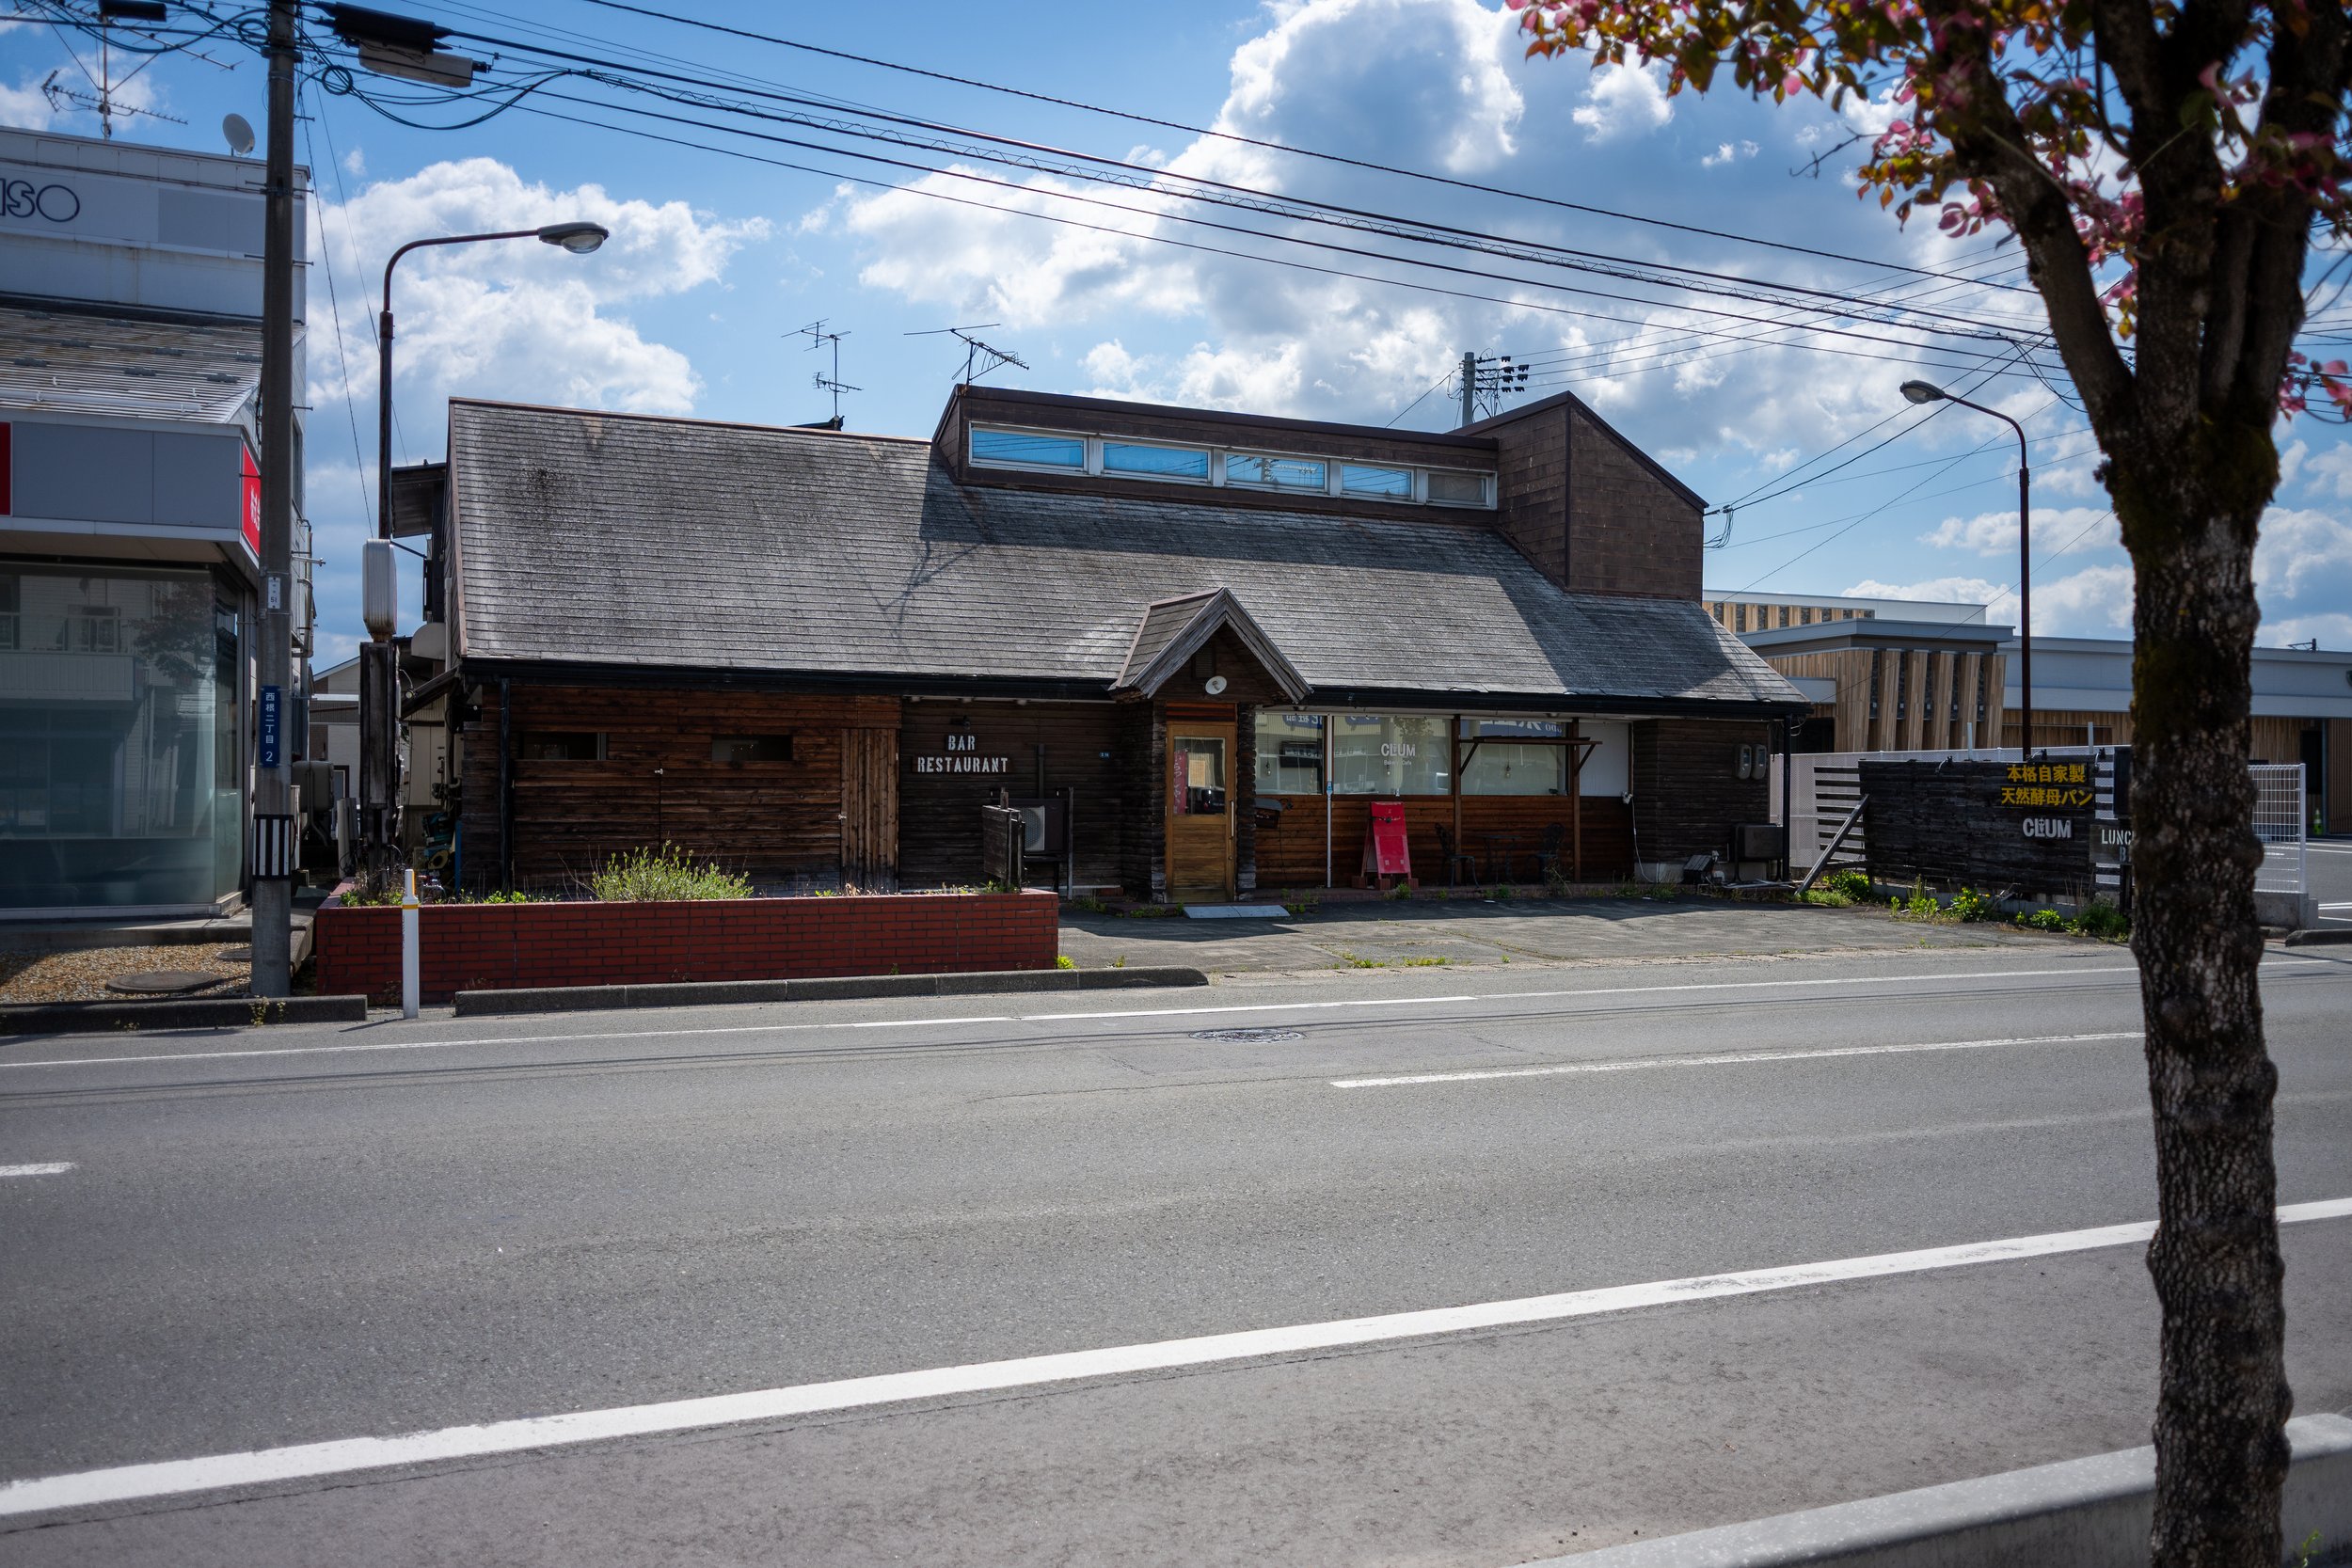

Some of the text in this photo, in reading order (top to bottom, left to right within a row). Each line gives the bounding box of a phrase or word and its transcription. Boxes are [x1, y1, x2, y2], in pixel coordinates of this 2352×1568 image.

[265, 692, 276, 762] 西根二丁目 2
[947, 735, 976, 751] BAR
[1380, 743, 1416, 757] CLUM
[917, 756, 1009, 773] RESTAURANT
[2007, 764, 2086, 784] 本格自家製
[2001, 787, 2093, 806] 天然酵母パン
[2023, 817, 2073, 839] CLUM
